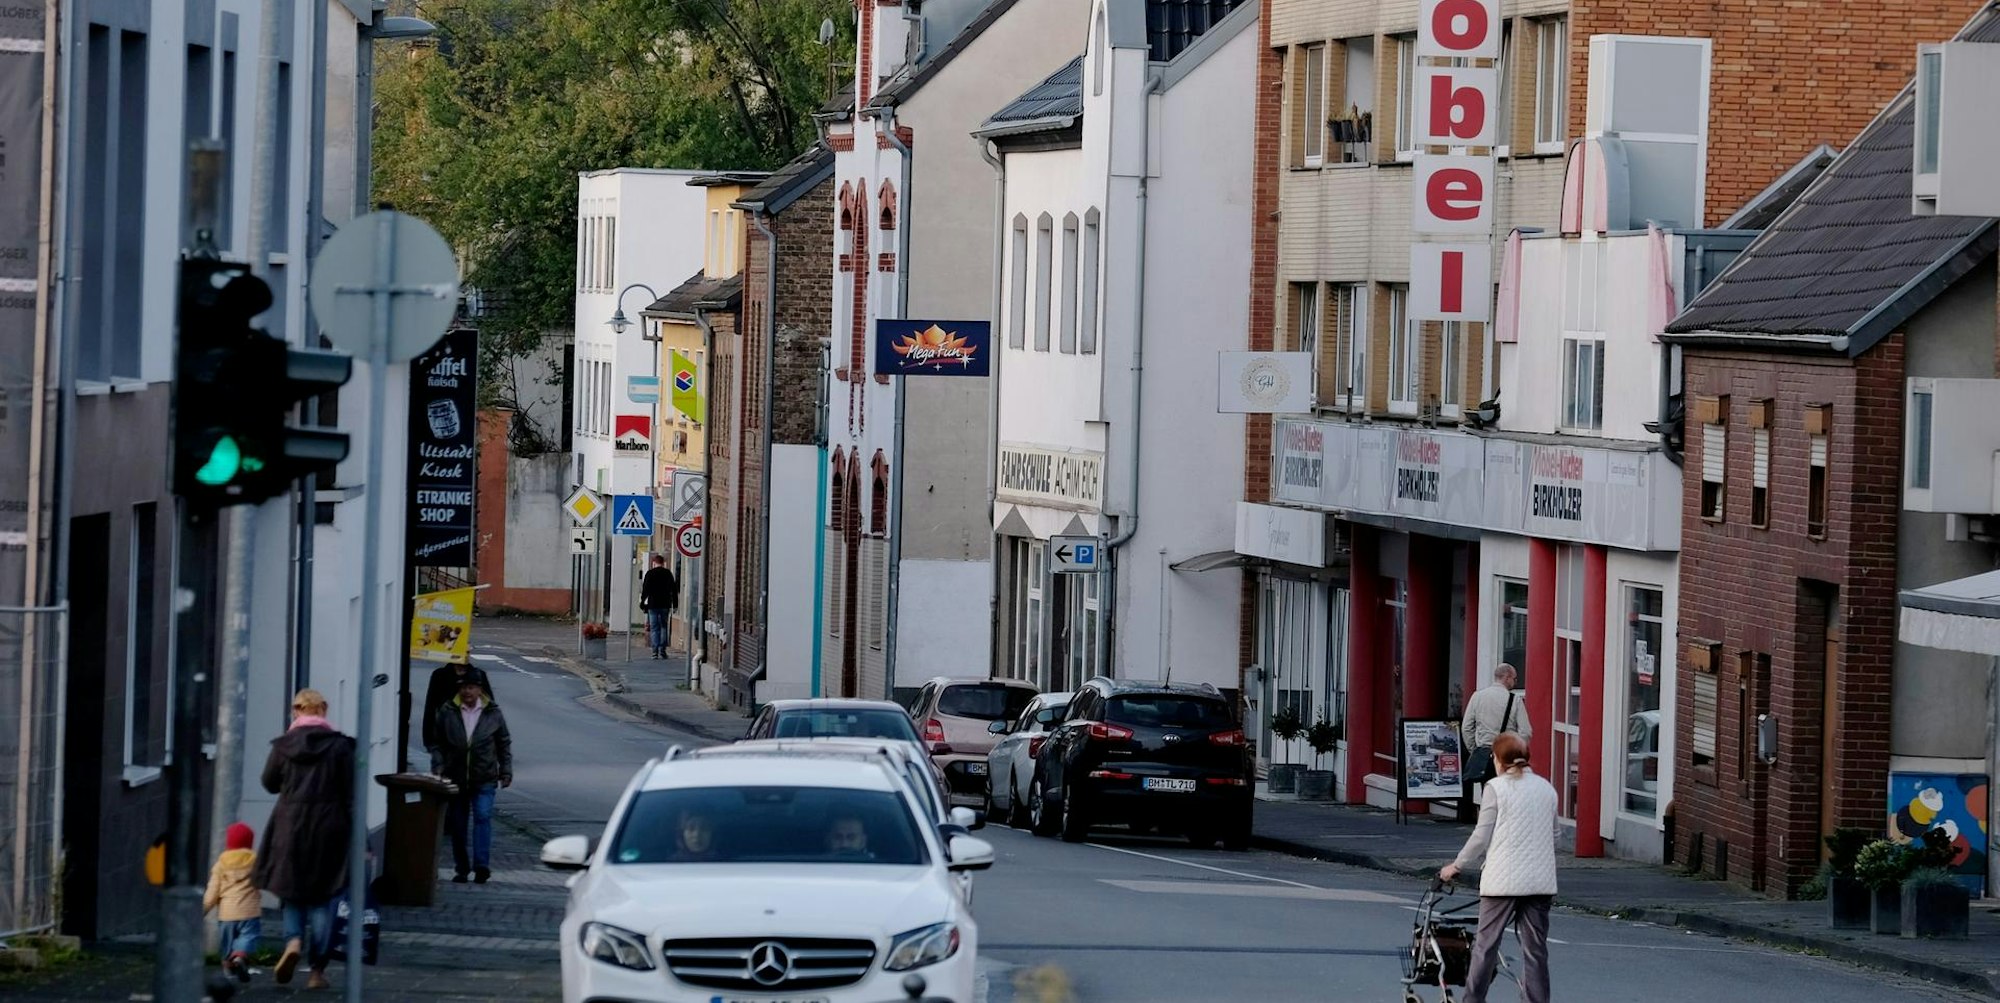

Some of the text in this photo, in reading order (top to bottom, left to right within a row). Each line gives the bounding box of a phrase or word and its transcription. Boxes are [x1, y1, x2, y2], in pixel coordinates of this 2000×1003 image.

[906, 341, 961, 366] Mega Fun
[615, 438, 650, 451] Marlboro
[419, 462, 463, 478] Kiosk
[1001, 450, 1052, 493] FAHRSCHULE
[1054, 456, 1081, 499] ACHIM
[1533, 480, 1582, 522] BIRKHÖLZER
[420, 508, 455, 522] SHOP
[683, 532, 702, 548] 30
[1079, 546, 1090, 562] P
[1149, 778, 1160, 788] BM
[1178, 780, 1195, 790] 710
